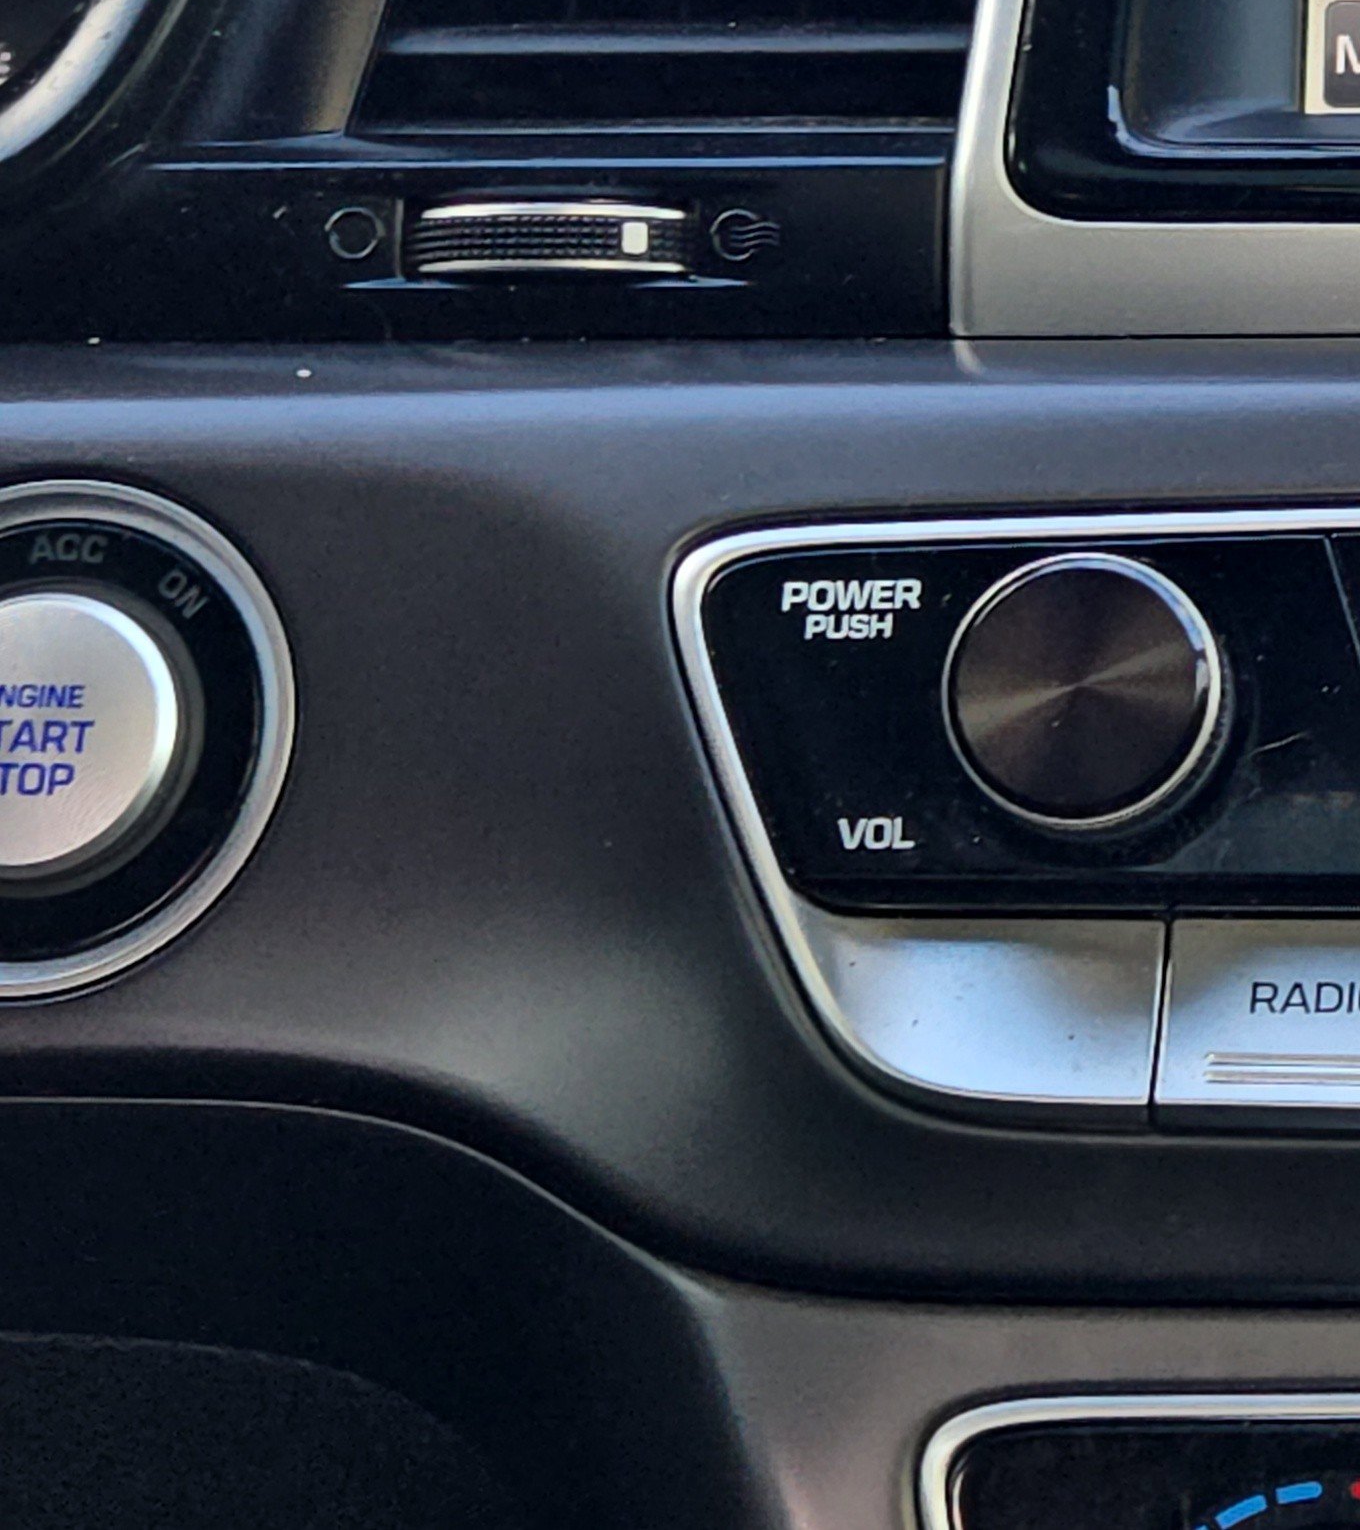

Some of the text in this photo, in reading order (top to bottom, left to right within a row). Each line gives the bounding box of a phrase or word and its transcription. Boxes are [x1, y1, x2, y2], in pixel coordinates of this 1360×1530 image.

[29, 532, 109, 565] ACC
[157, 569, 208, 619] ON
[781, 577, 923, 613] POWER
[803, 613, 894, 641] PUSH
[0, 684, 86, 709] NGINE
[0, 719, 95, 754] TART
[0, 762, 76, 796] TOP
[837, 816, 916, 851] VOL
